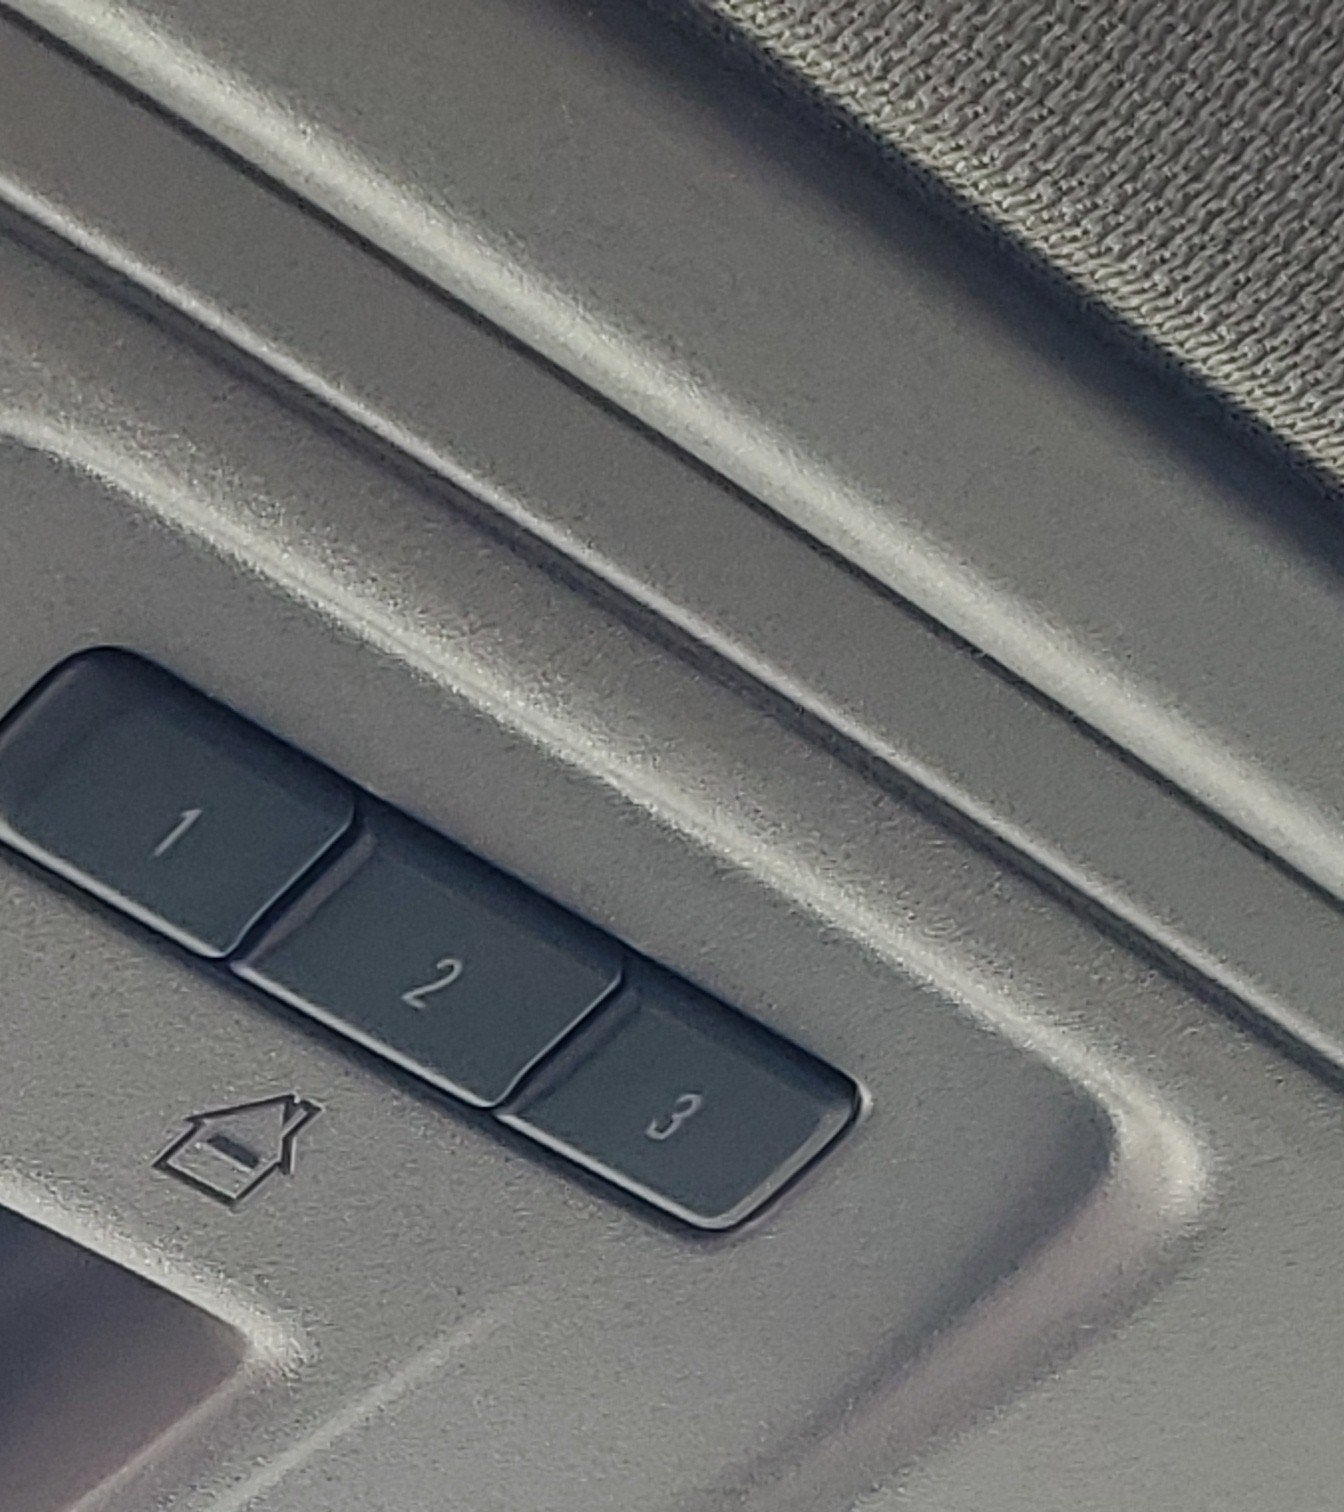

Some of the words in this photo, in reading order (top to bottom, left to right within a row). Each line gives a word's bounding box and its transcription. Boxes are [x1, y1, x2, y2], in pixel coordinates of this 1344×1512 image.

[151, 807, 202, 857] 1
[401, 958, 464, 1008] 2
[645, 1092, 704, 1141] 3
